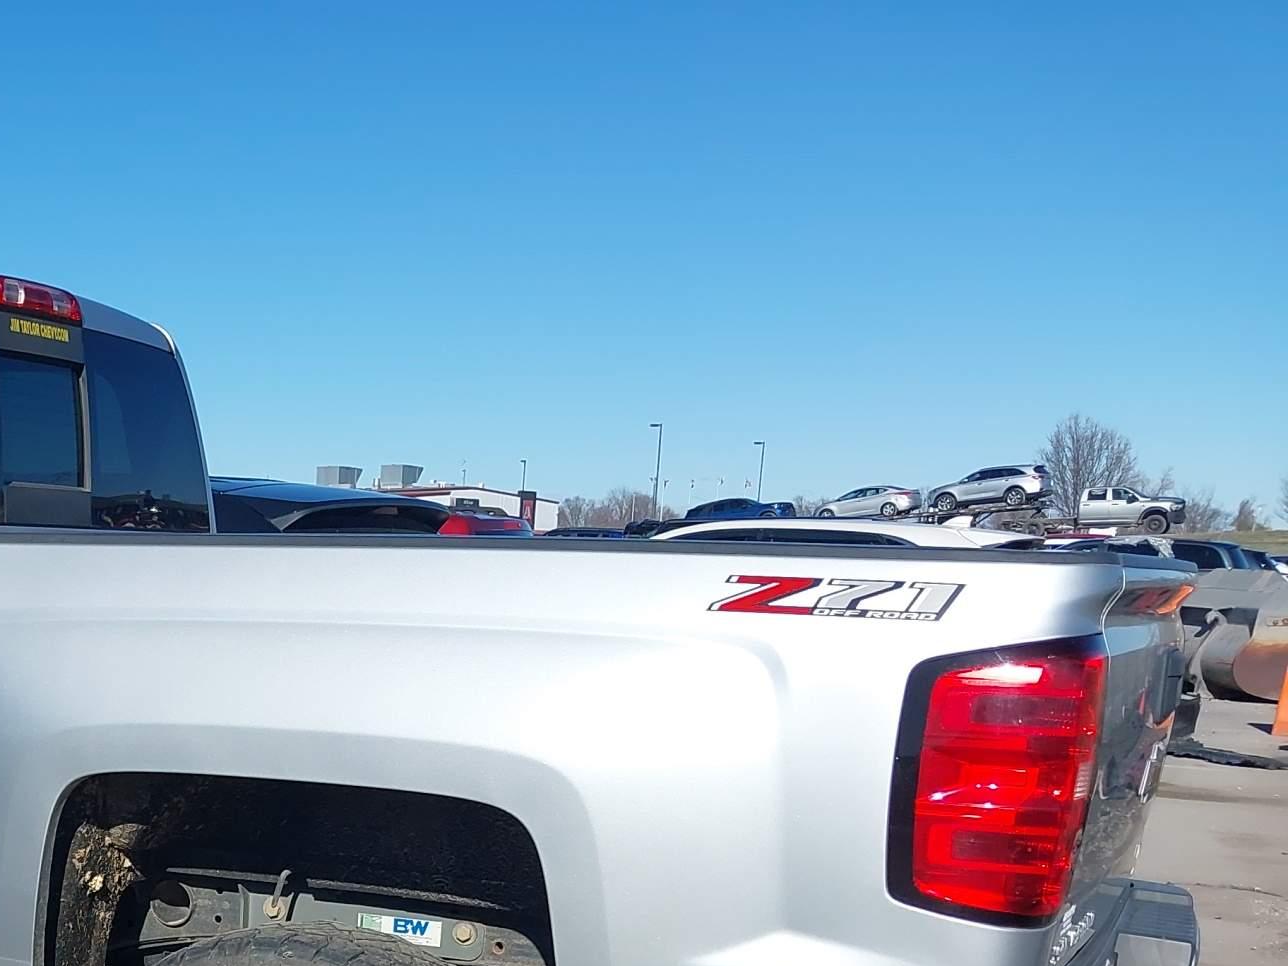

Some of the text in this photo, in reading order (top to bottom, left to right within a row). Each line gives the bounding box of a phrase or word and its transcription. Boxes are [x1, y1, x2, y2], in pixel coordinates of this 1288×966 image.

[707, 575, 967, 616] Z71
[812, 608, 938, 621] OFF ROAD
